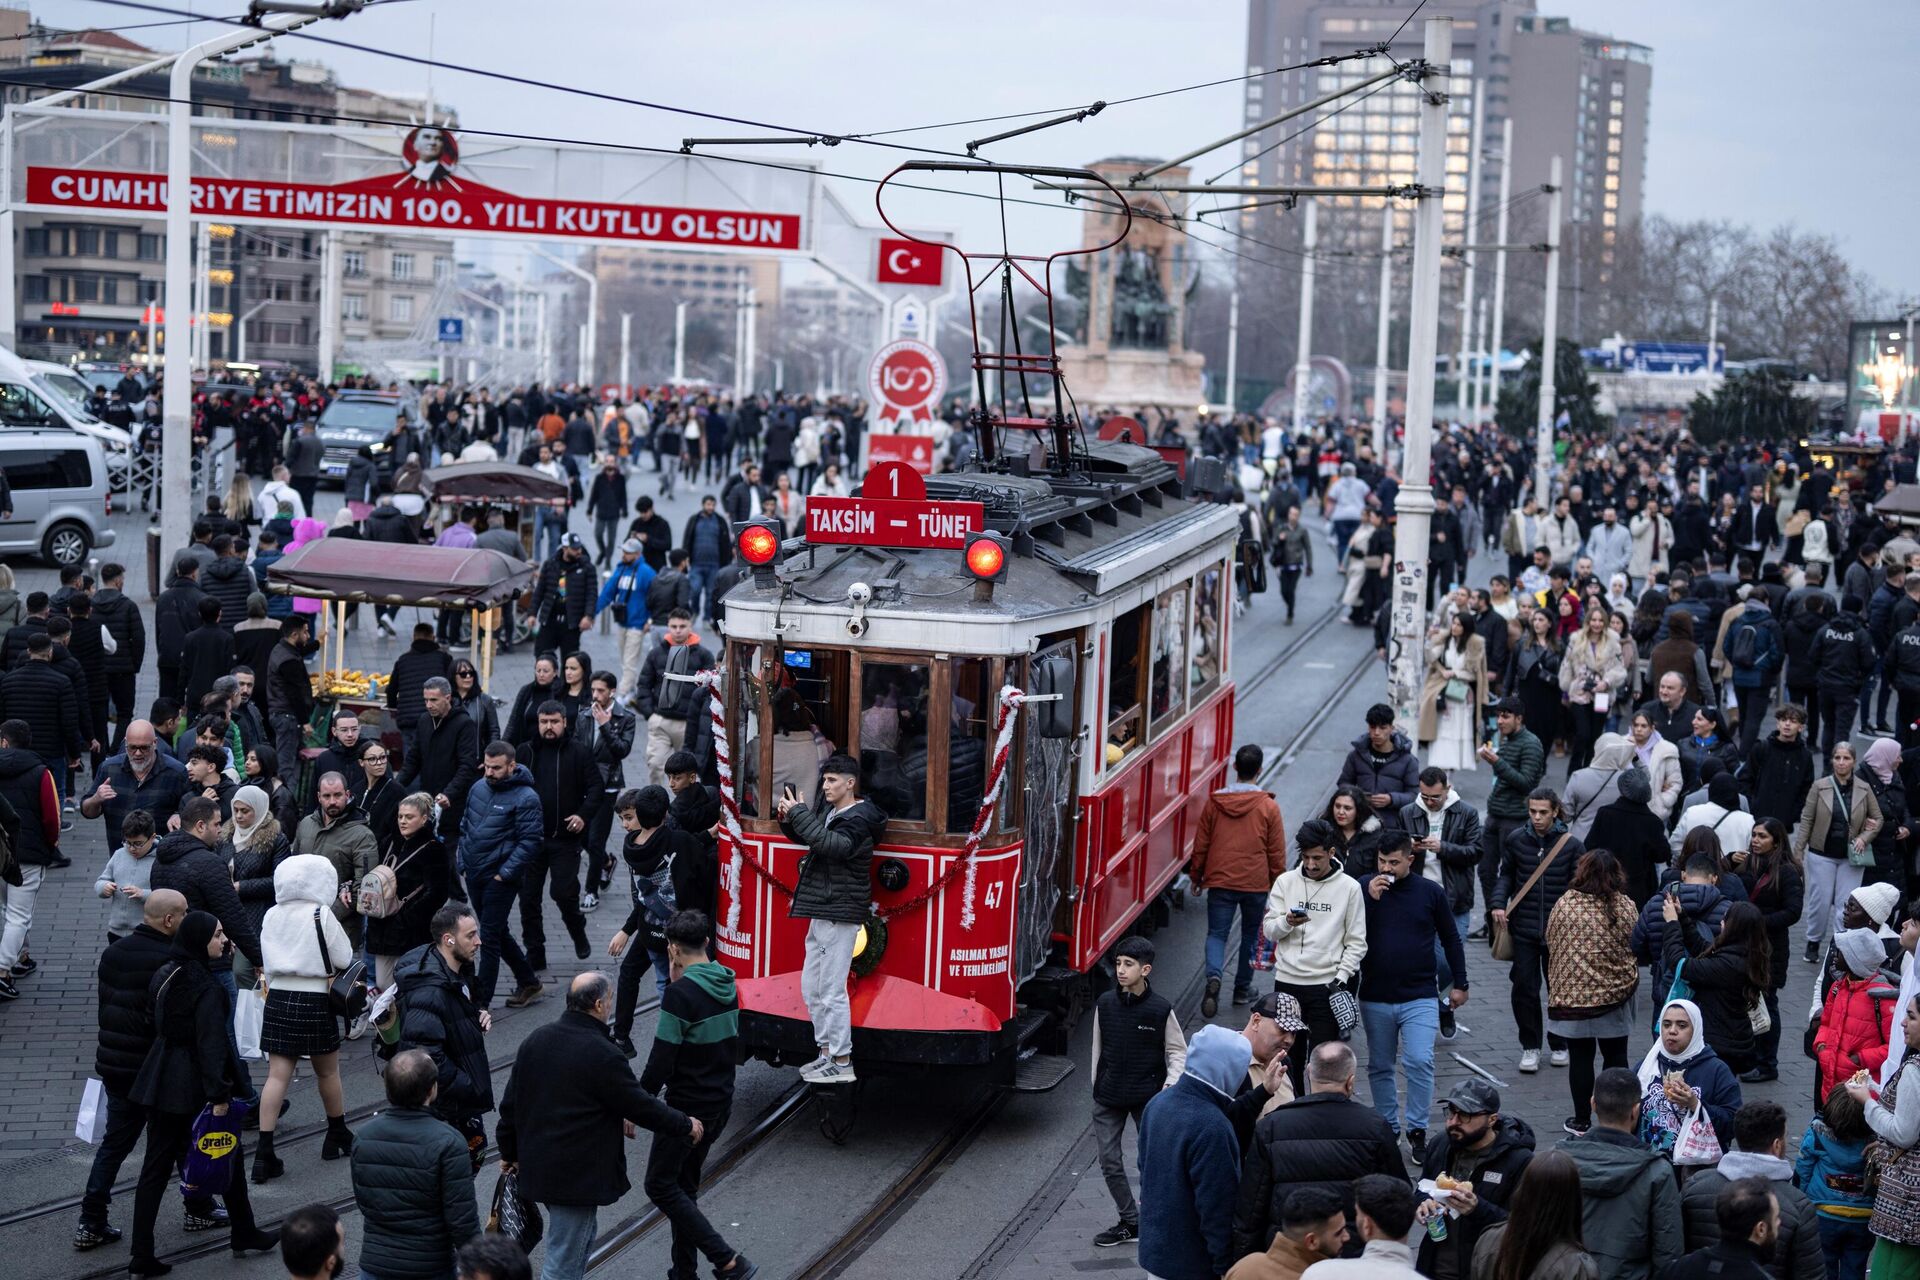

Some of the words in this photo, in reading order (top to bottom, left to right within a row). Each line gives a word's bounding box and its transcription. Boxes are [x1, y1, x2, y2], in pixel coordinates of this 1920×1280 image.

[402, 198, 472, 224] 100.
[482, 202, 545, 229] YILI
[555, 207, 661, 235] KUTLU
[671, 214, 782, 243] OLSUN
[889, 468, 898, 496] 1
[811, 504, 875, 533] TAKSİM
[984, 881, 1004, 909] 47
[950, 948, 988, 961] ASILMAK
[989, 945, 1008, 960] YASAK
[949, 964, 960, 977] VE
[202, 1134, 232, 1150] gratis
